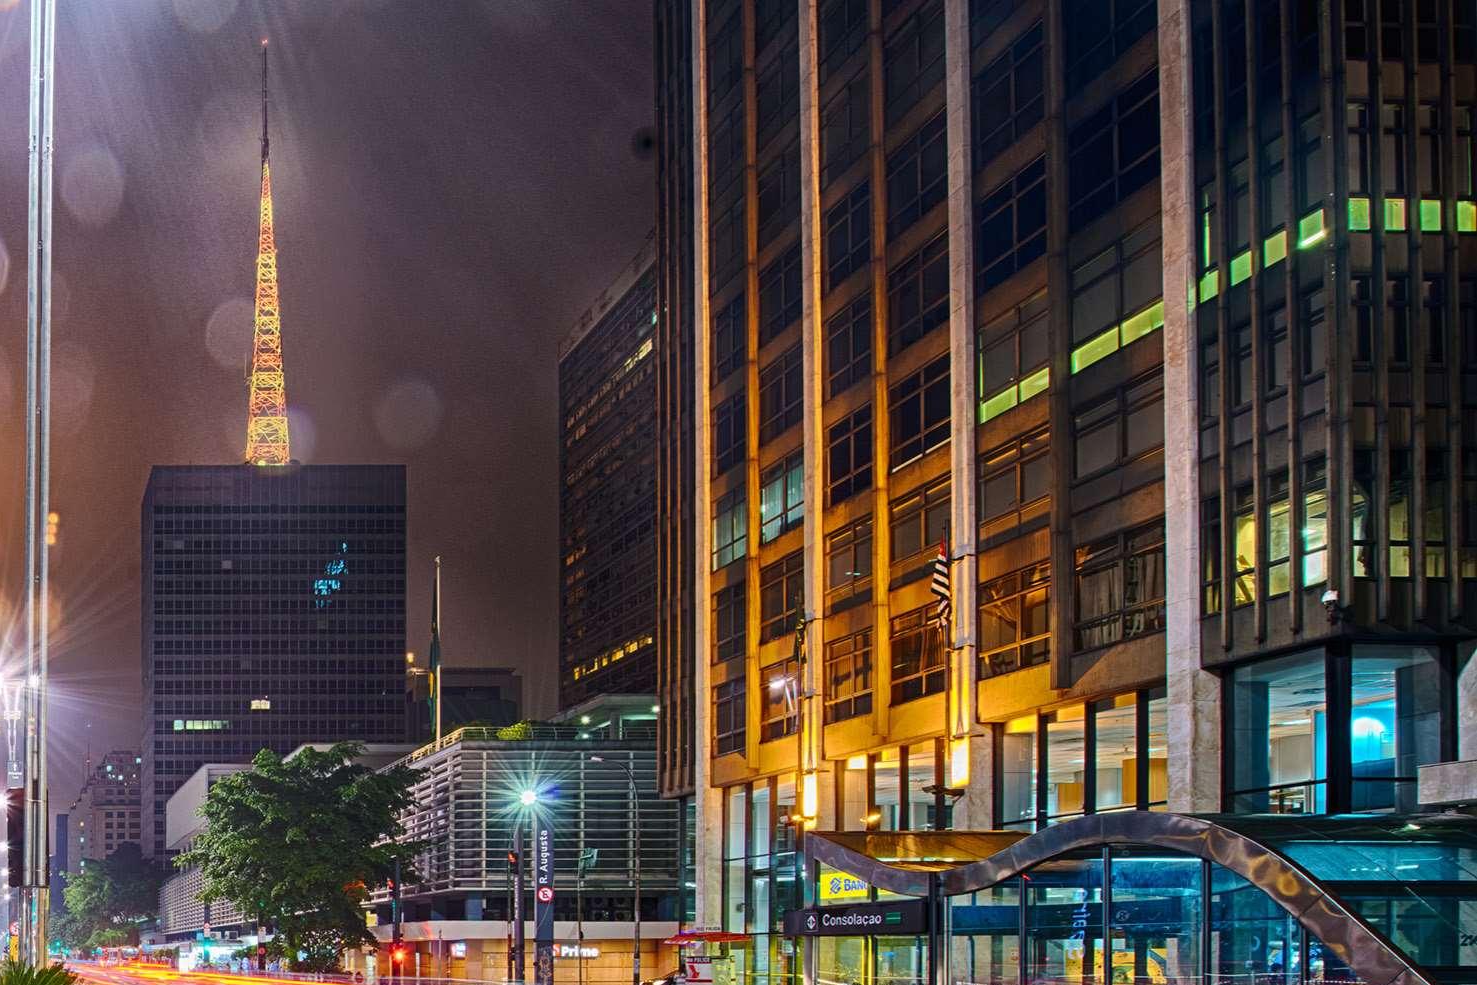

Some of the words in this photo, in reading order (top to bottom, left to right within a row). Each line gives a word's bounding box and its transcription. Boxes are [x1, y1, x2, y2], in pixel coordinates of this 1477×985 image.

[539, 830, 550, 872] Augusta
[844, 879, 867, 890] BAN
[561, 945, 599, 958] Prime
